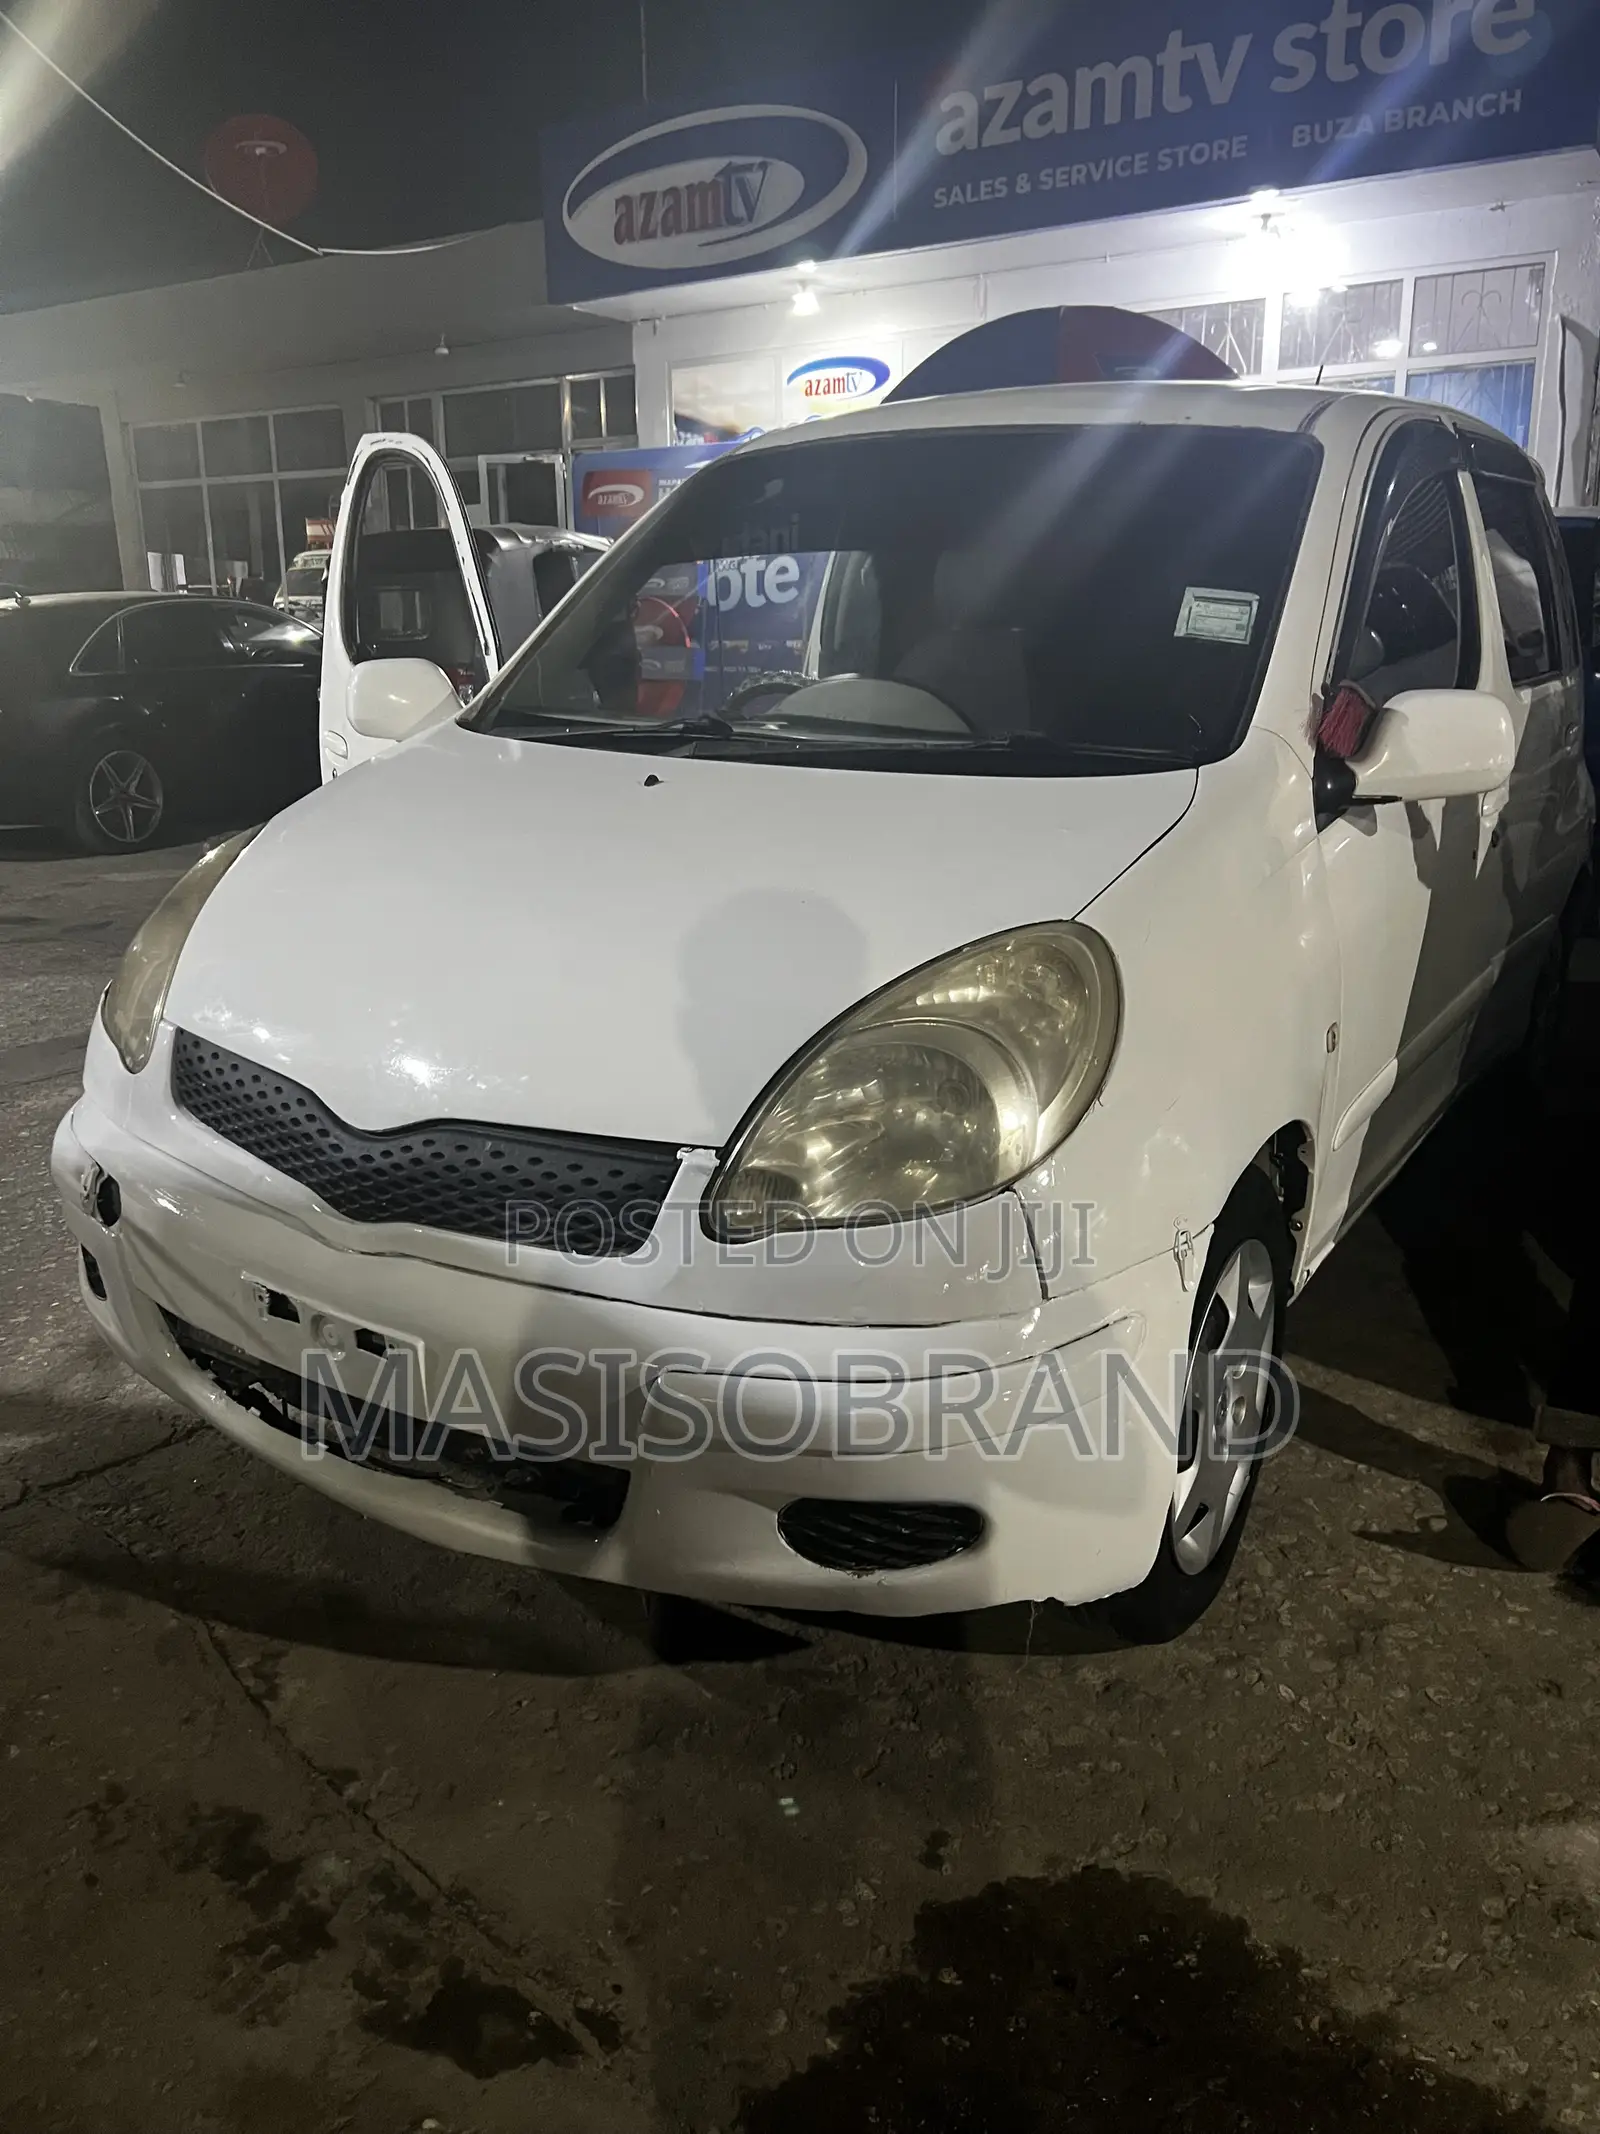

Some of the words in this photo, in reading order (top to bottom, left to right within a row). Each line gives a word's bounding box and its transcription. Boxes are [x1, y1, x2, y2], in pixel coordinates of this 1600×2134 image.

[935, 29, 1253, 156] azamtv
[1269, 0, 1535, 93] store
[1291, 116, 1376, 148] BUZA
[1383, 88, 1523, 133] BRANCH
[613, 160, 771, 246] azamtv
[933, 176, 1008, 209] SALES
[1015, 172, 1031, 194] &
[1038, 152, 1149, 191] SERVICE
[1157, 135, 1248, 172] STORE
[803, 371, 863, 398] azamtv
